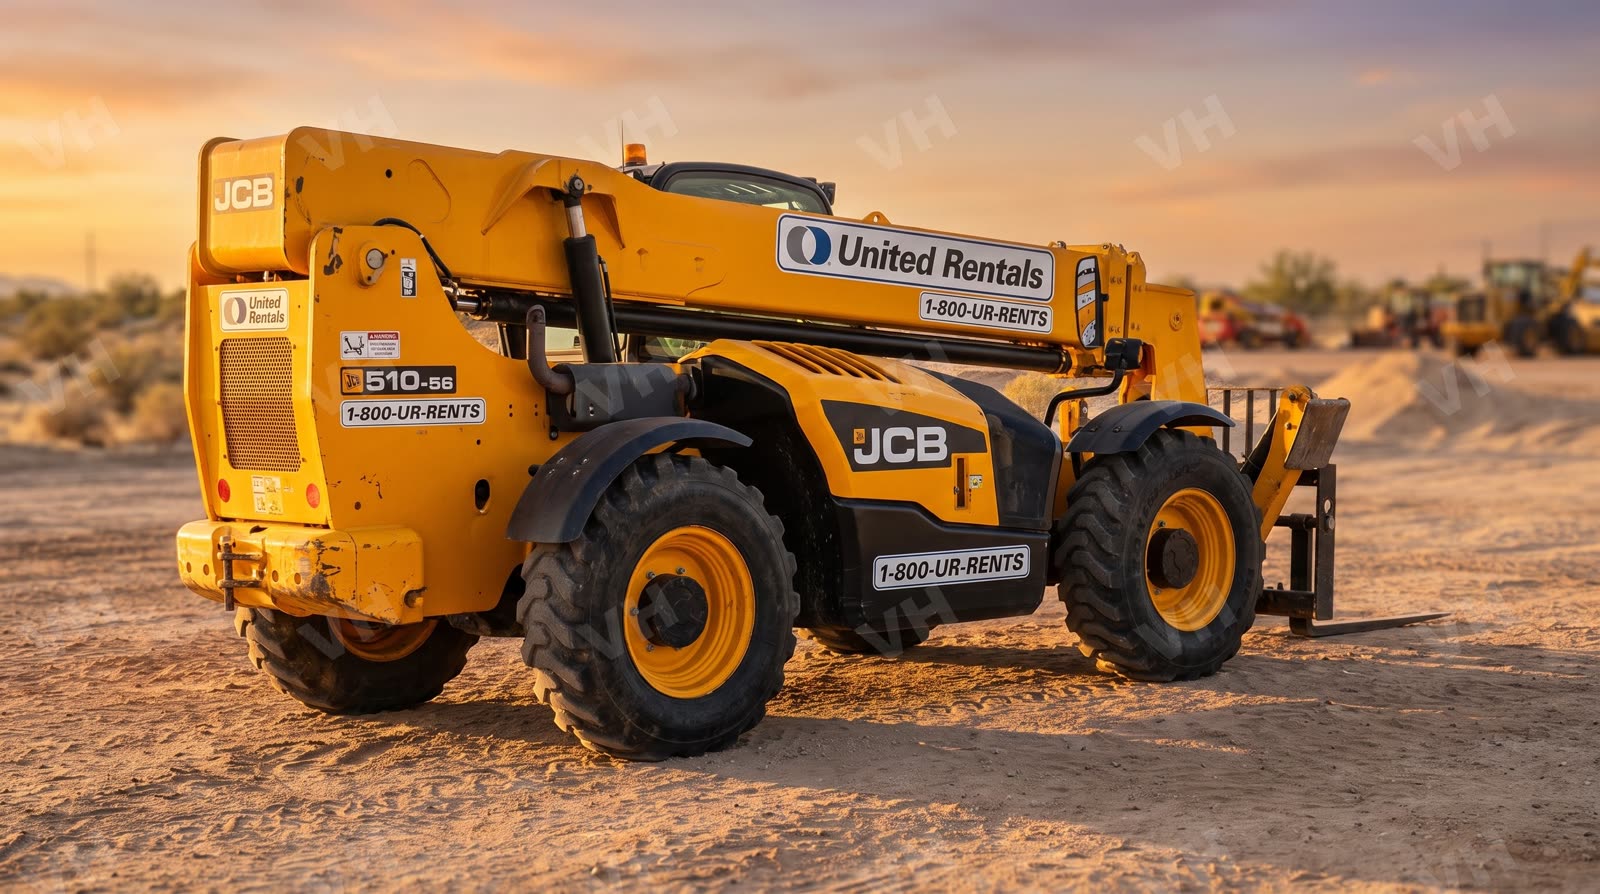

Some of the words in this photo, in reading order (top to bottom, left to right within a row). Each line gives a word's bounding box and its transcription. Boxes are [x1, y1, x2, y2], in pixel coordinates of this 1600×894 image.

[214, 177, 273, 211] JCB
[838, 234, 937, 276] United
[942, 248, 1044, 290] Rentals
[249, 295, 281, 310] United
[249, 310, 285, 324] Rentals
[924, 298, 1048, 327] 1-800-UR-RENTS
[366, 370, 454, 391] 510-56
[346, 403, 480, 422] 1-800-UR-RENTS
[853, 426, 948, 465] JCB
[880, 552, 1025, 582] 1-800-UR-RENTS
